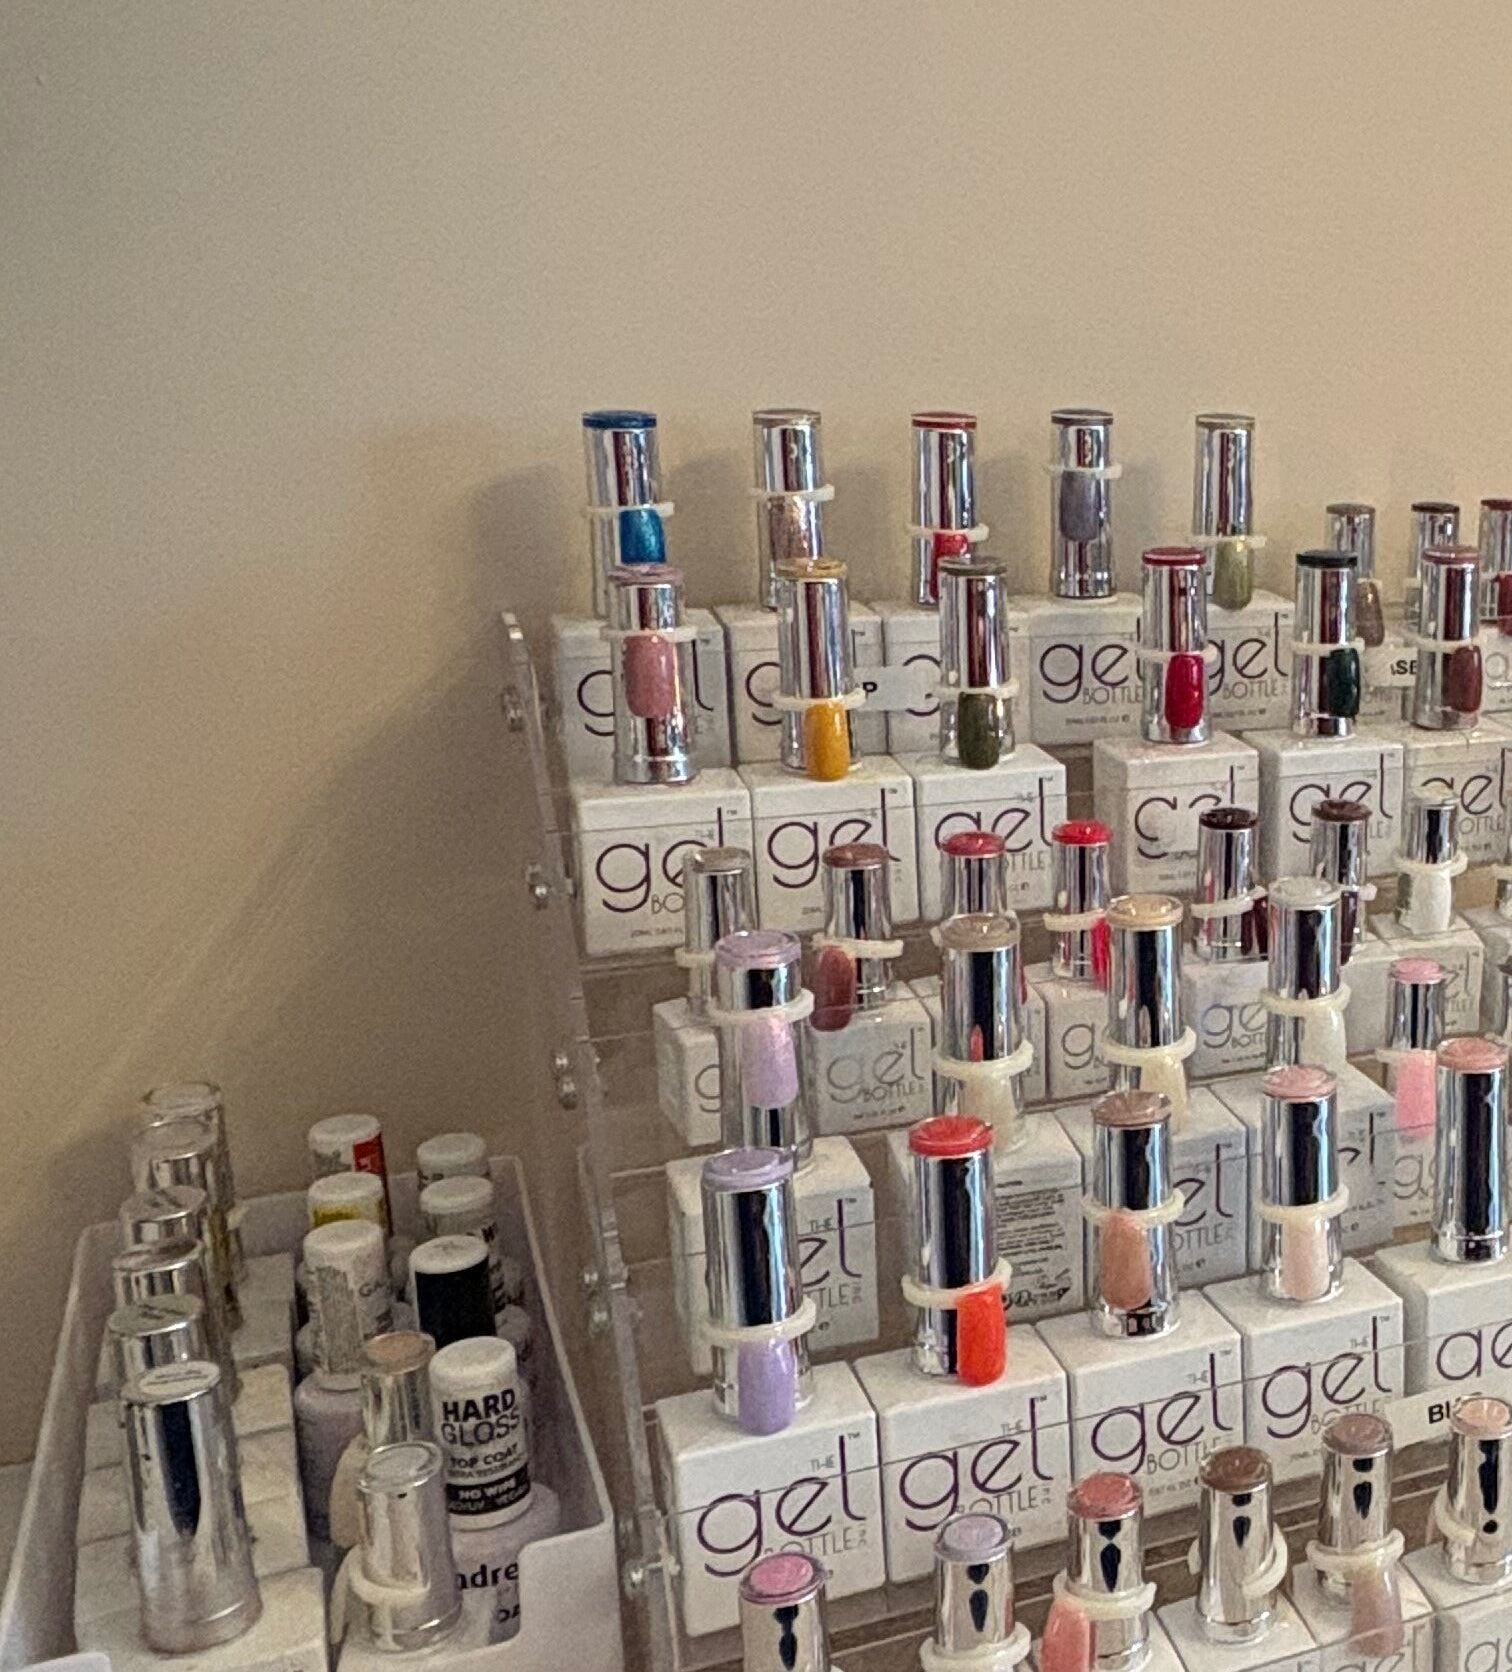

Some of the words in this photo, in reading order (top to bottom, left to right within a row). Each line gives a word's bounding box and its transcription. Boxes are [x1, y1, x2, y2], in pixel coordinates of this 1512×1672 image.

[1039, 616, 1144, 703] gel
[441, 1404, 520, 1447] GLOSS
[442, 1388, 515, 1422] HARD
[1091, 1353, 1234, 1475] gel
[1262, 1315, 1392, 1439] gel
[450, 1457, 478, 1469] TOP
[484, 1443, 518, 1465] COAT
[697, 1435, 867, 1578] gel
[900, 1397, 1054, 1532] gel
